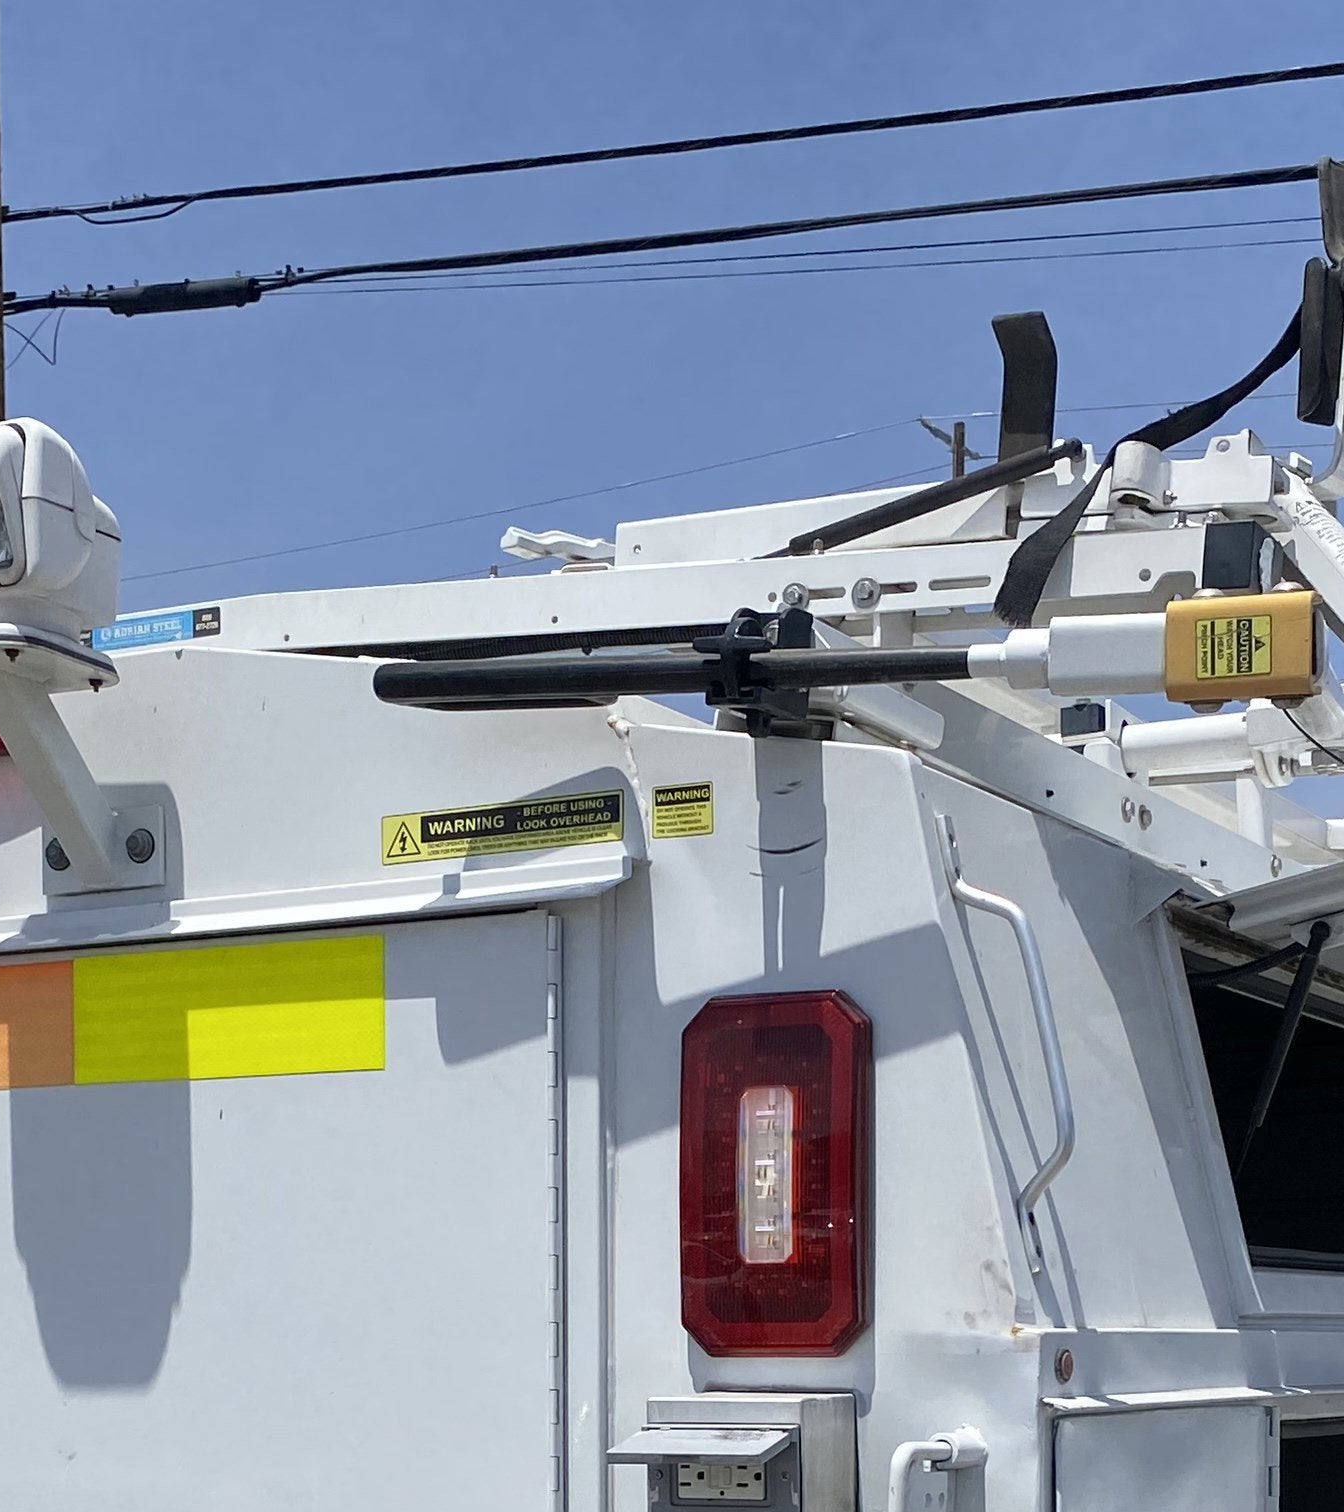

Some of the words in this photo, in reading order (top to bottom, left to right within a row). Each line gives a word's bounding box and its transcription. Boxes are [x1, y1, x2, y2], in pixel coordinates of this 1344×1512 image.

[114, 623, 150, 638] ADRIAN
[153, 620, 182, 633] STEEL
[1239, 620, 1249, 672] CAUTION
[656, 788, 710, 802] WARNING
[522, 802, 568, 817] BEFORE
[570, 798, 604, 813] USING
[428, 814, 505, 836] WARNING
[516, 818, 548, 831] LOOK
[550, 811, 612, 827] OVERHEAD
